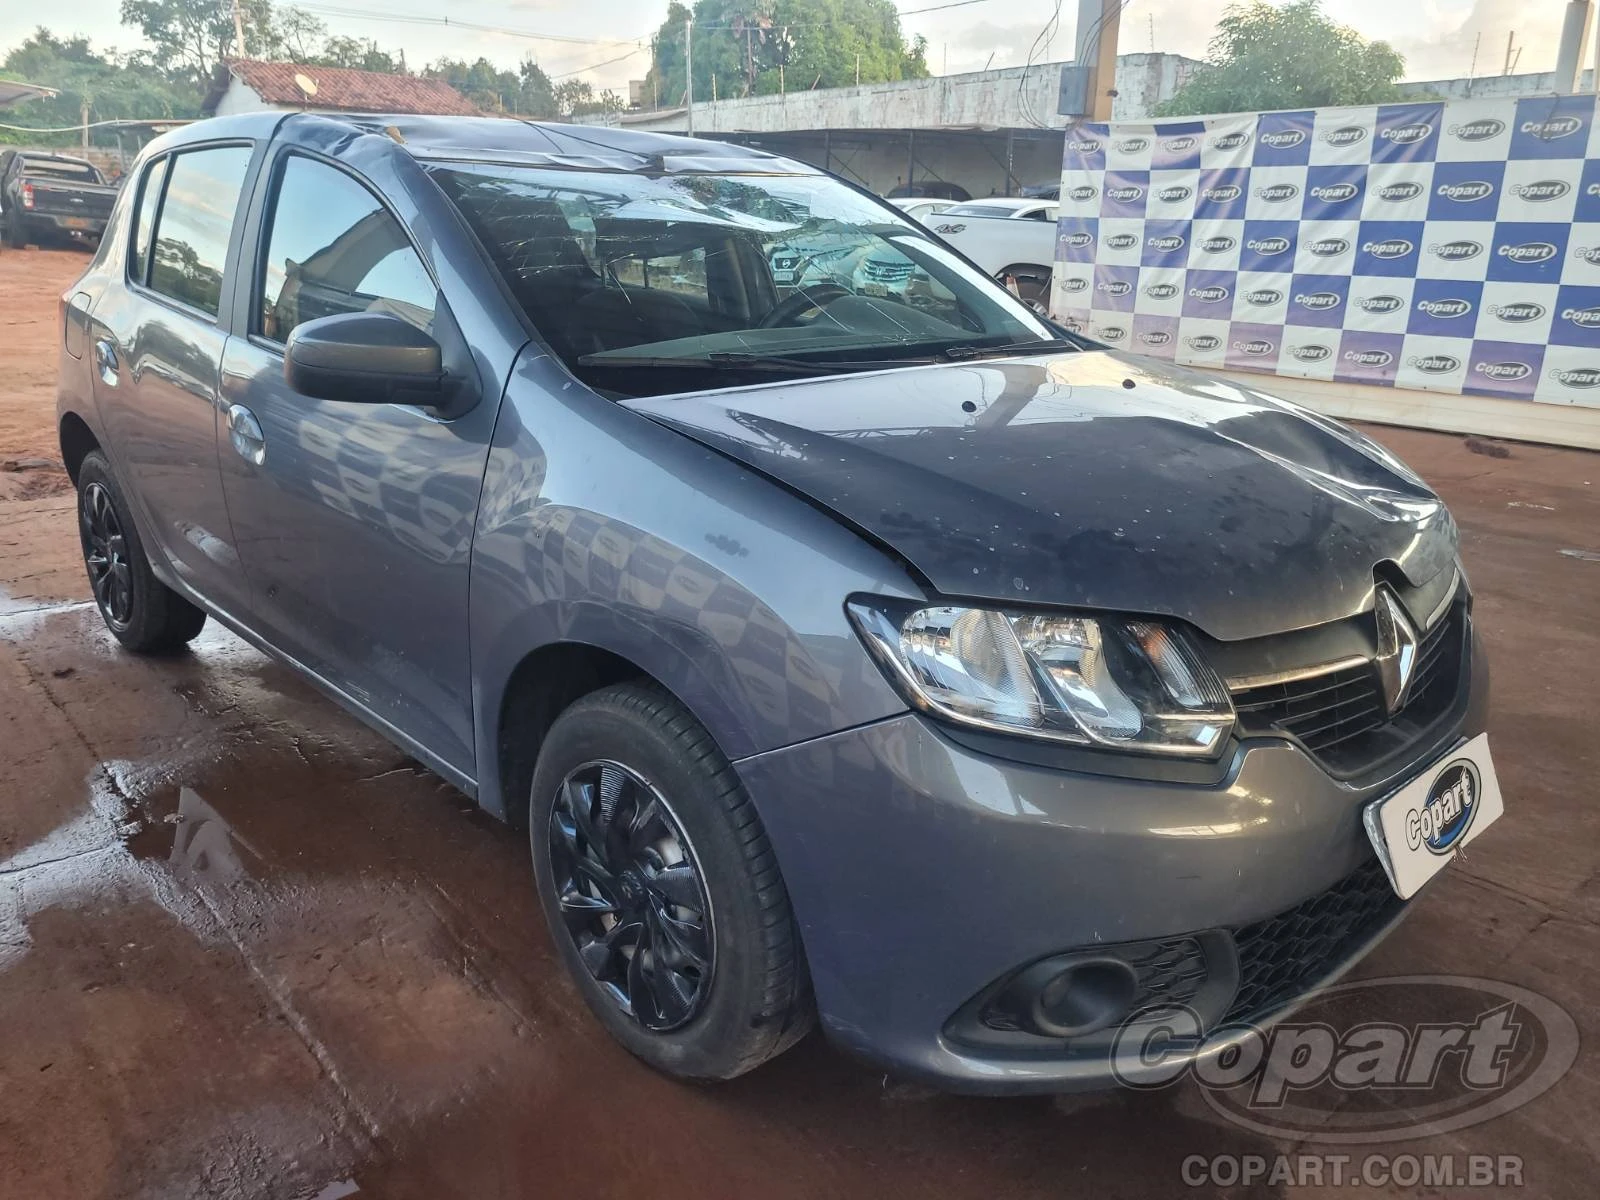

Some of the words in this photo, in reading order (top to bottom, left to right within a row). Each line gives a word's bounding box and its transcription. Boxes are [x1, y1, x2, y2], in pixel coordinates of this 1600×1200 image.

[1381, 125, 1425, 140] Copart
[1448, 123, 1496, 136] Copart
[1261, 132, 1300, 144] Copart
[1107, 188, 1139, 199] Copart
[1202, 187, 1237, 199] Copart
[1311, 185, 1351, 198] Copart
[1438, 184, 1486, 197] Copart
[1509, 183, 1561, 197] Copart
[1060, 234, 1089, 244] Copart
[1148, 237, 1179, 248] Copart
[1247, 239, 1284, 251] Copart
[1303, 240, 1343, 252] Copart
[1362, 242, 1407, 254] Copart
[1428, 243, 1475, 257] Copart
[1498, 245, 1549, 258] Copart
[1098, 282, 1128, 292] Copart
[1189, 288, 1222, 299] Copart
[1295, 294, 1334, 306] Copart
[1355, 297, 1397, 310] Copart
[1418, 300, 1464, 314] Copart
[1488, 304, 1537, 318] Copart
[1137, 332, 1168, 343] Copart
[1184, 336, 1217, 348] Copart
[1233, 341, 1269, 353] Copart
[1344, 351, 1387, 364] Copart
[1475, 362, 1526, 376] Copart
[1405, 765, 1474, 851] Copart
